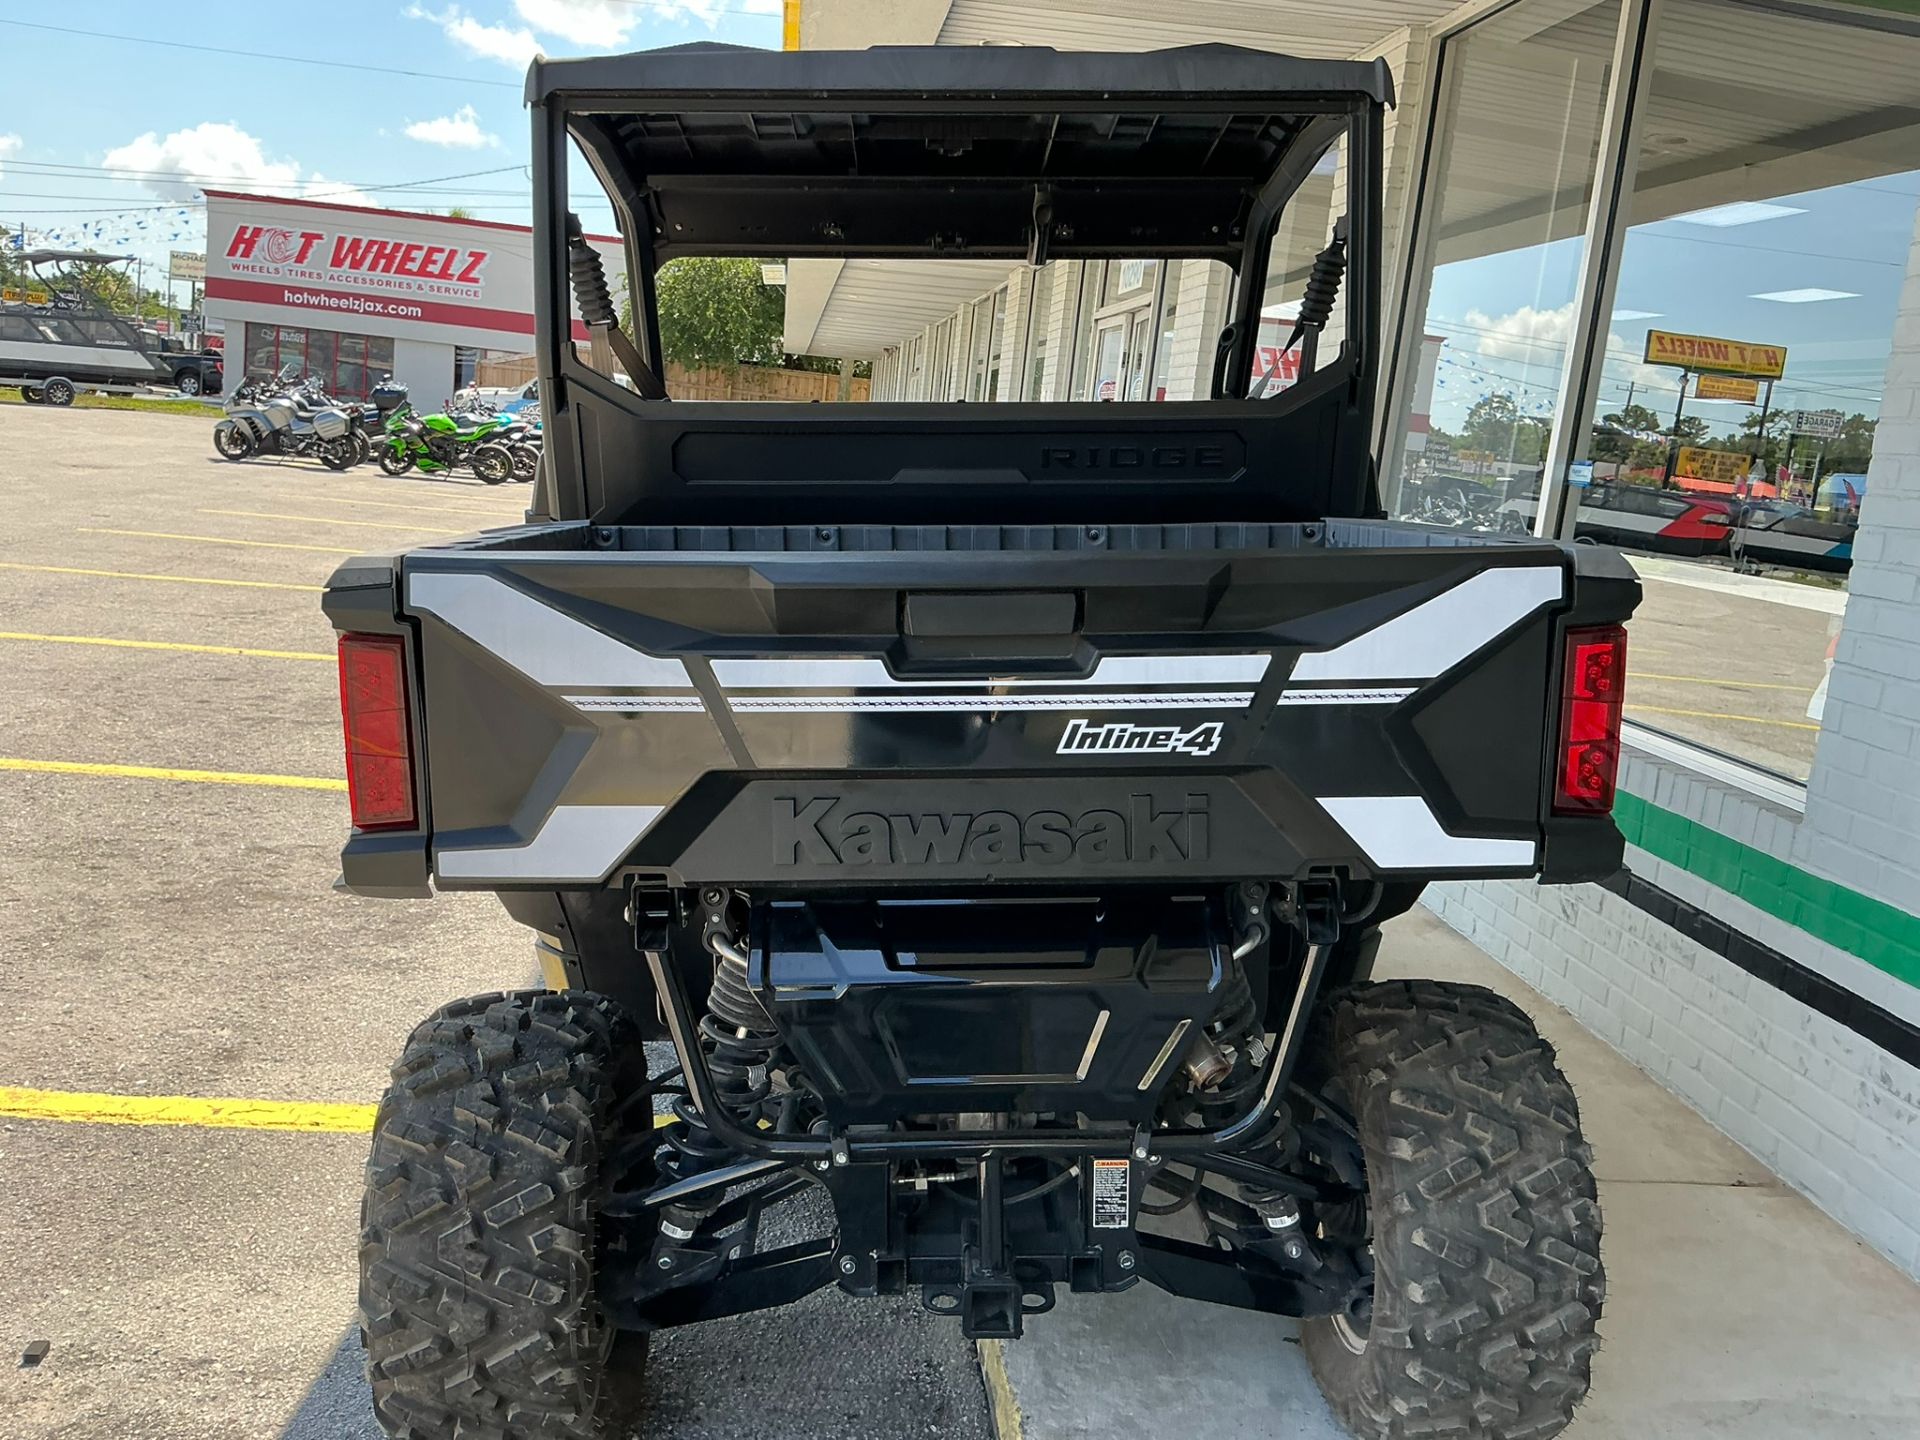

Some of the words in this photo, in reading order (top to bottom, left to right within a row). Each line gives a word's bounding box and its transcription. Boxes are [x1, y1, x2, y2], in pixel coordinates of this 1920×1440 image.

[329, 235, 487, 284] WHEELZ
[231, 262, 281, 275] WHEELS
[287, 268, 323, 280] TIRES
[328, 273, 413, 290] ACCESSORIES
[416, 283, 424, 291] &
[428, 284, 481, 298] SERVICE
[284, 290, 422, 317] hotwheelzjax.com
[1042, 446, 1225, 468] RIDGE
[1056, 719, 1224, 756] Inline-4
[773, 793, 1210, 866] Kawasaki
